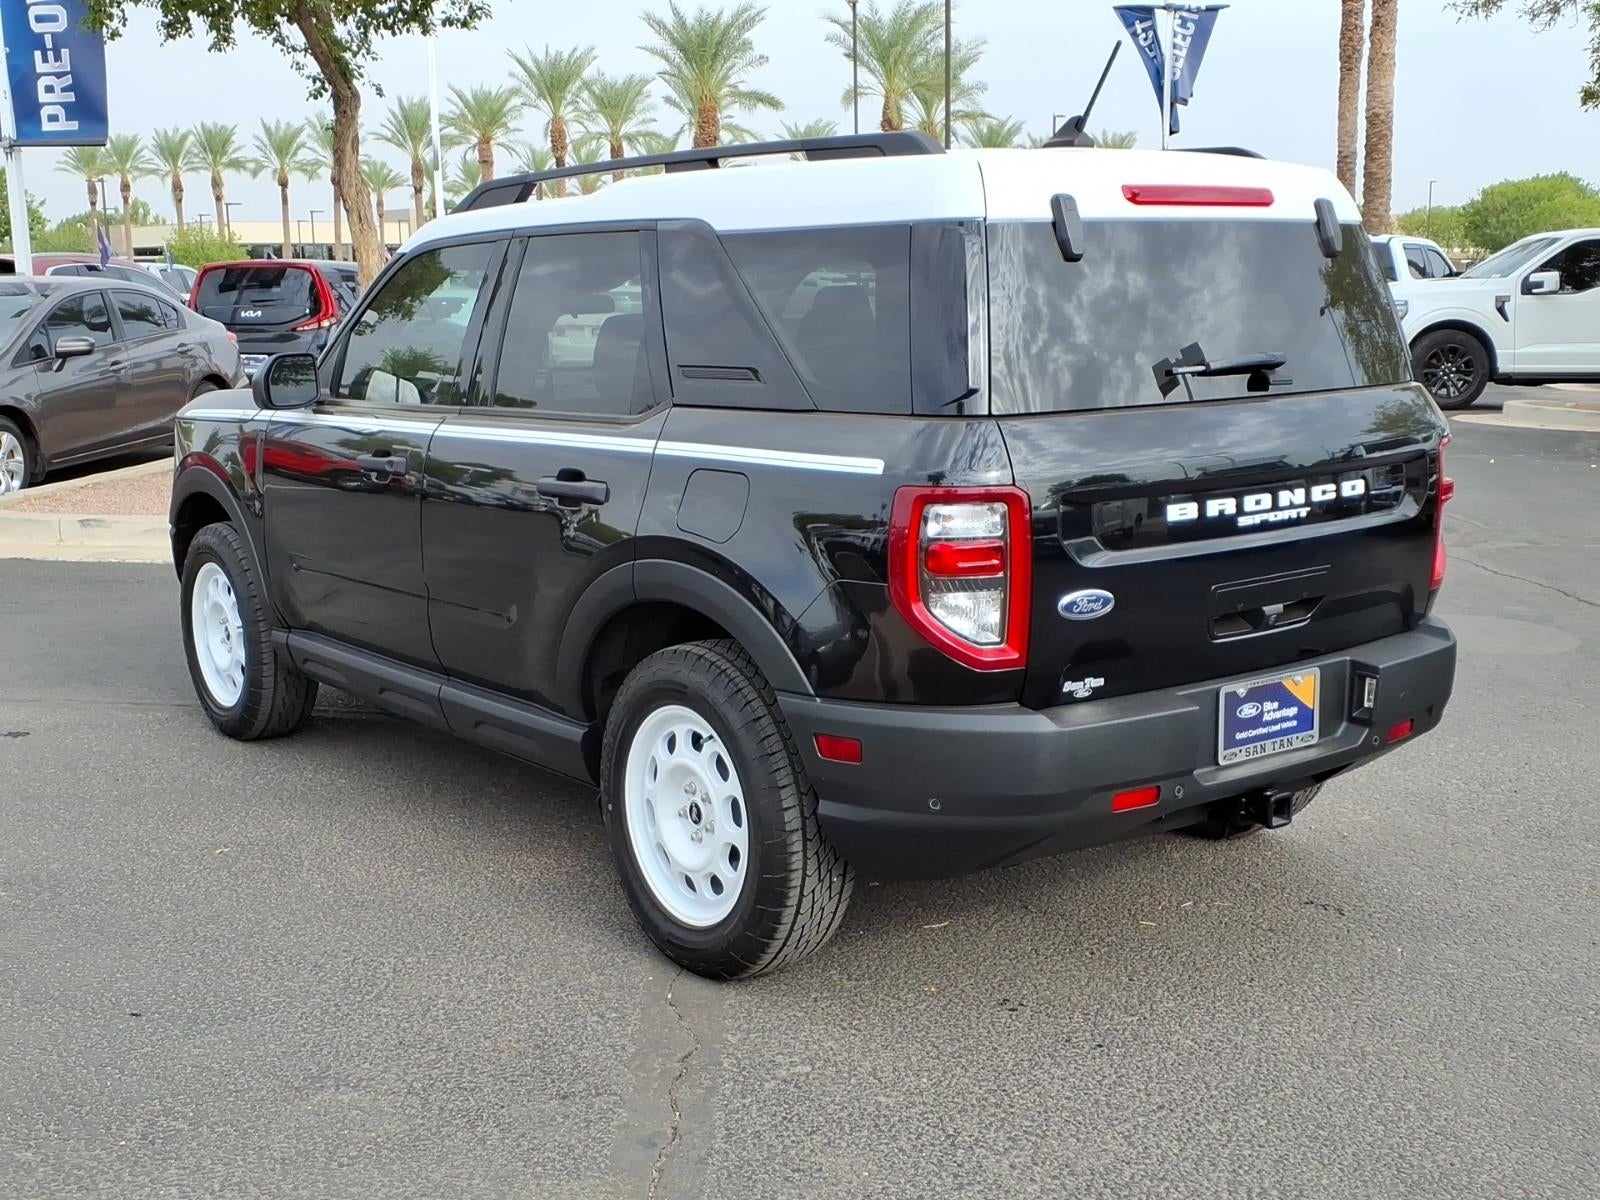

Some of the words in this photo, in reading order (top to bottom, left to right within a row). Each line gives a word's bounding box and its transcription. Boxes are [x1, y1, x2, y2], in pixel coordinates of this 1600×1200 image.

[26, 0, 78, 132] PRE-O
[1166, 479, 1366, 522] BRONCO
[1237, 507, 1311, 527] SPORT
[1262, 706, 1298, 721] Advantage
[1263, 701, 1279, 712] Blue
[1235, 731, 1248, 739] Gold
[1248, 726, 1268, 737] Certified
[1269, 723, 1281, 733] Used
[1281, 720, 1298, 729] Vehicle
[1245, 743, 1266, 757] SAN
[1271, 736, 1293, 751] TAN
